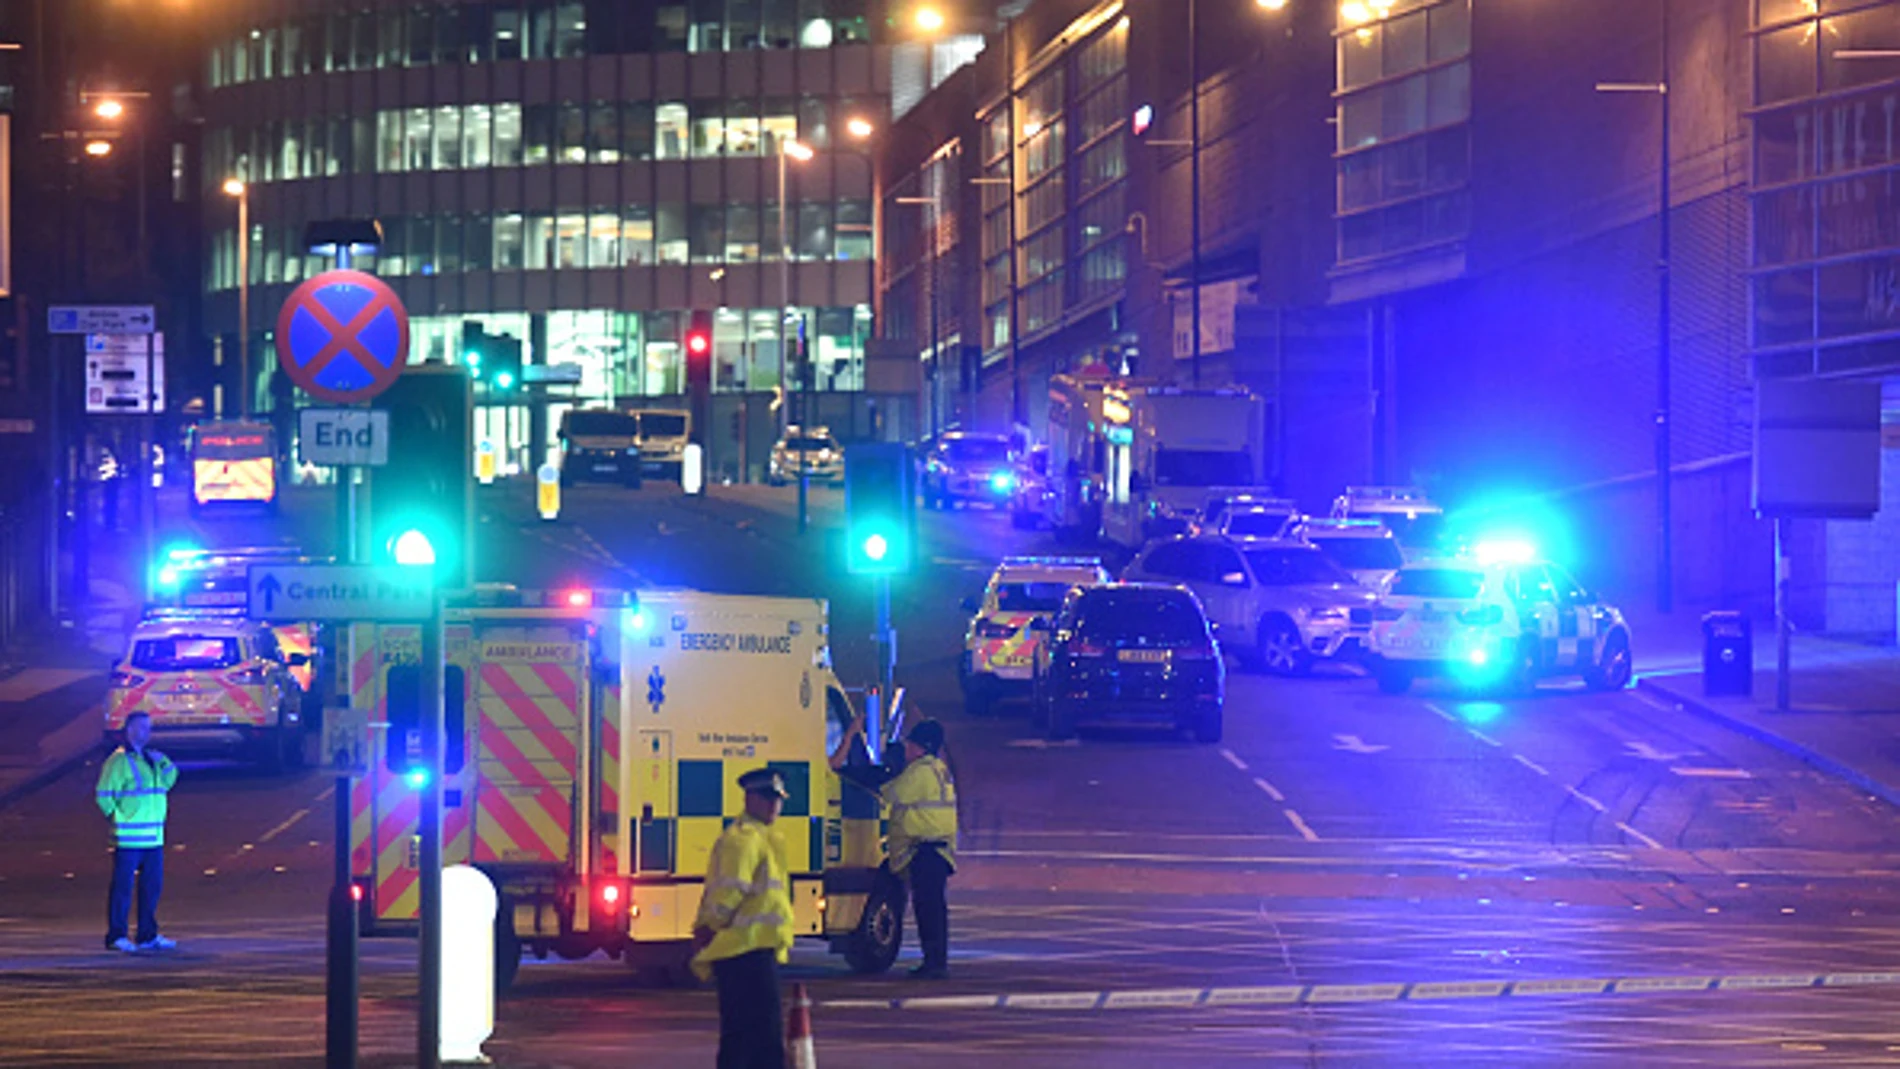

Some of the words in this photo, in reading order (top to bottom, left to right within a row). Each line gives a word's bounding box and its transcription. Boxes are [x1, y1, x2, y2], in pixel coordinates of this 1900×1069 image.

[316, 422, 372, 447] End
[287, 581, 369, 600] Central
[485, 645, 572, 660] AMBULANCE
[681, 633, 736, 651] EMERGENCY
[738, 633, 791, 653] AMBULANCE
